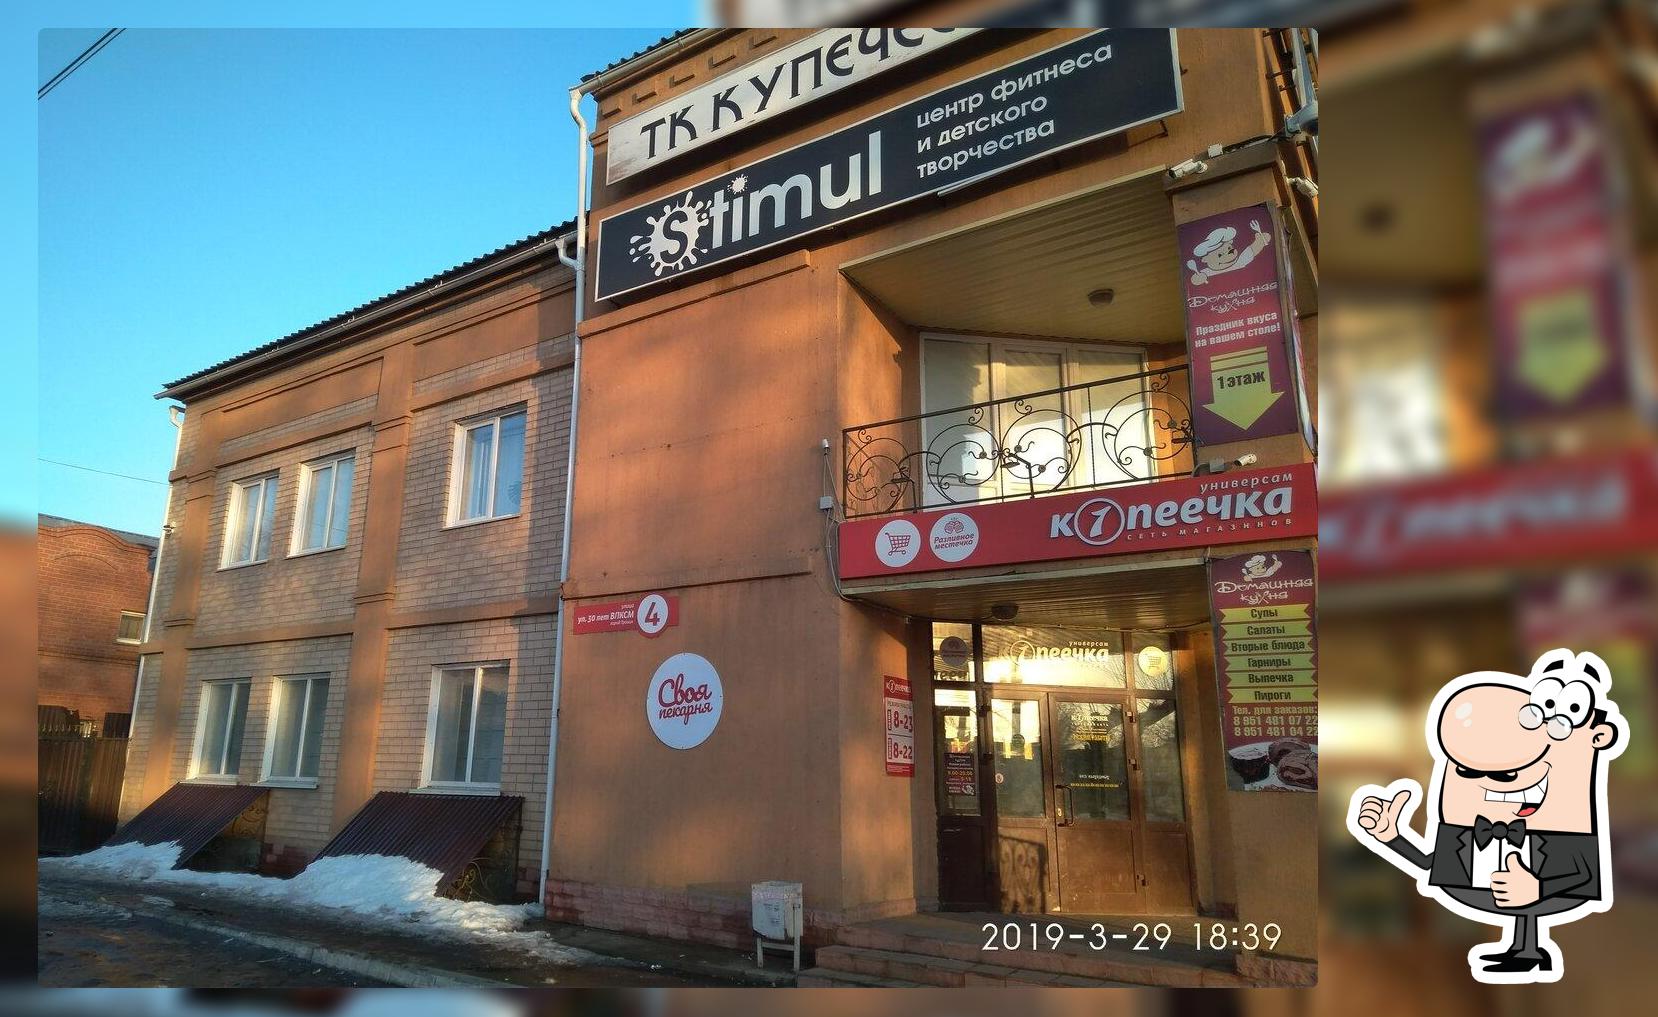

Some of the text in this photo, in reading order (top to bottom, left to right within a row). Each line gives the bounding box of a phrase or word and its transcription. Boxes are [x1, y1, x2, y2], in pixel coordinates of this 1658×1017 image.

[917, 45, 1112, 128] центр фитнеса
[640, 104, 698, 160] ТК
[917, 96, 1048, 154] и детского
[917, 119, 1055, 178] творчества
[657, 131, 882, 265] Stimul
[1188, 282, 1279, 308] Домашняя
[1211, 296, 1257, 314] кухня
[1196, 312, 1278, 336] Праздник вкуса
[1195, 322, 1281, 348] на вашем столе!
[1200, 472, 1293, 494] универсам
[1127, 530, 1168, 541] СЕТЬ
[1214, 578, 1314, 593] Домашняя
[1240, 591, 1289, 605] кухня
[610, 610, 634, 620] ВЛКСМ
[645, 602, 660, 626] 4
[1250, 608, 1278, 619] Супы
[1247, 625, 1286, 636] Салаты
[1231, 639, 1306, 653] Вторые блюда
[1247, 657, 1292, 669] Гарниры
[1248, 673, 1295, 684] Выпечка
[658, 673, 713, 708] Своя
[1254, 691, 1292, 702] Пироги
[659, 702, 714, 725] пекарня
[1232, 705, 1317, 716] Тел. для заказов:
[893, 710, 913, 734] 8-23
[1233, 716, 1241, 726] 8
[1243, 716, 1261, 726] 951
[1265, 716, 1285, 726] 481
[1234, 727, 1242, 737] 8
[1244, 727, 1262, 737] 951
[1267, 727, 1286, 737] 481
[893, 742, 913, 760] 8-22
